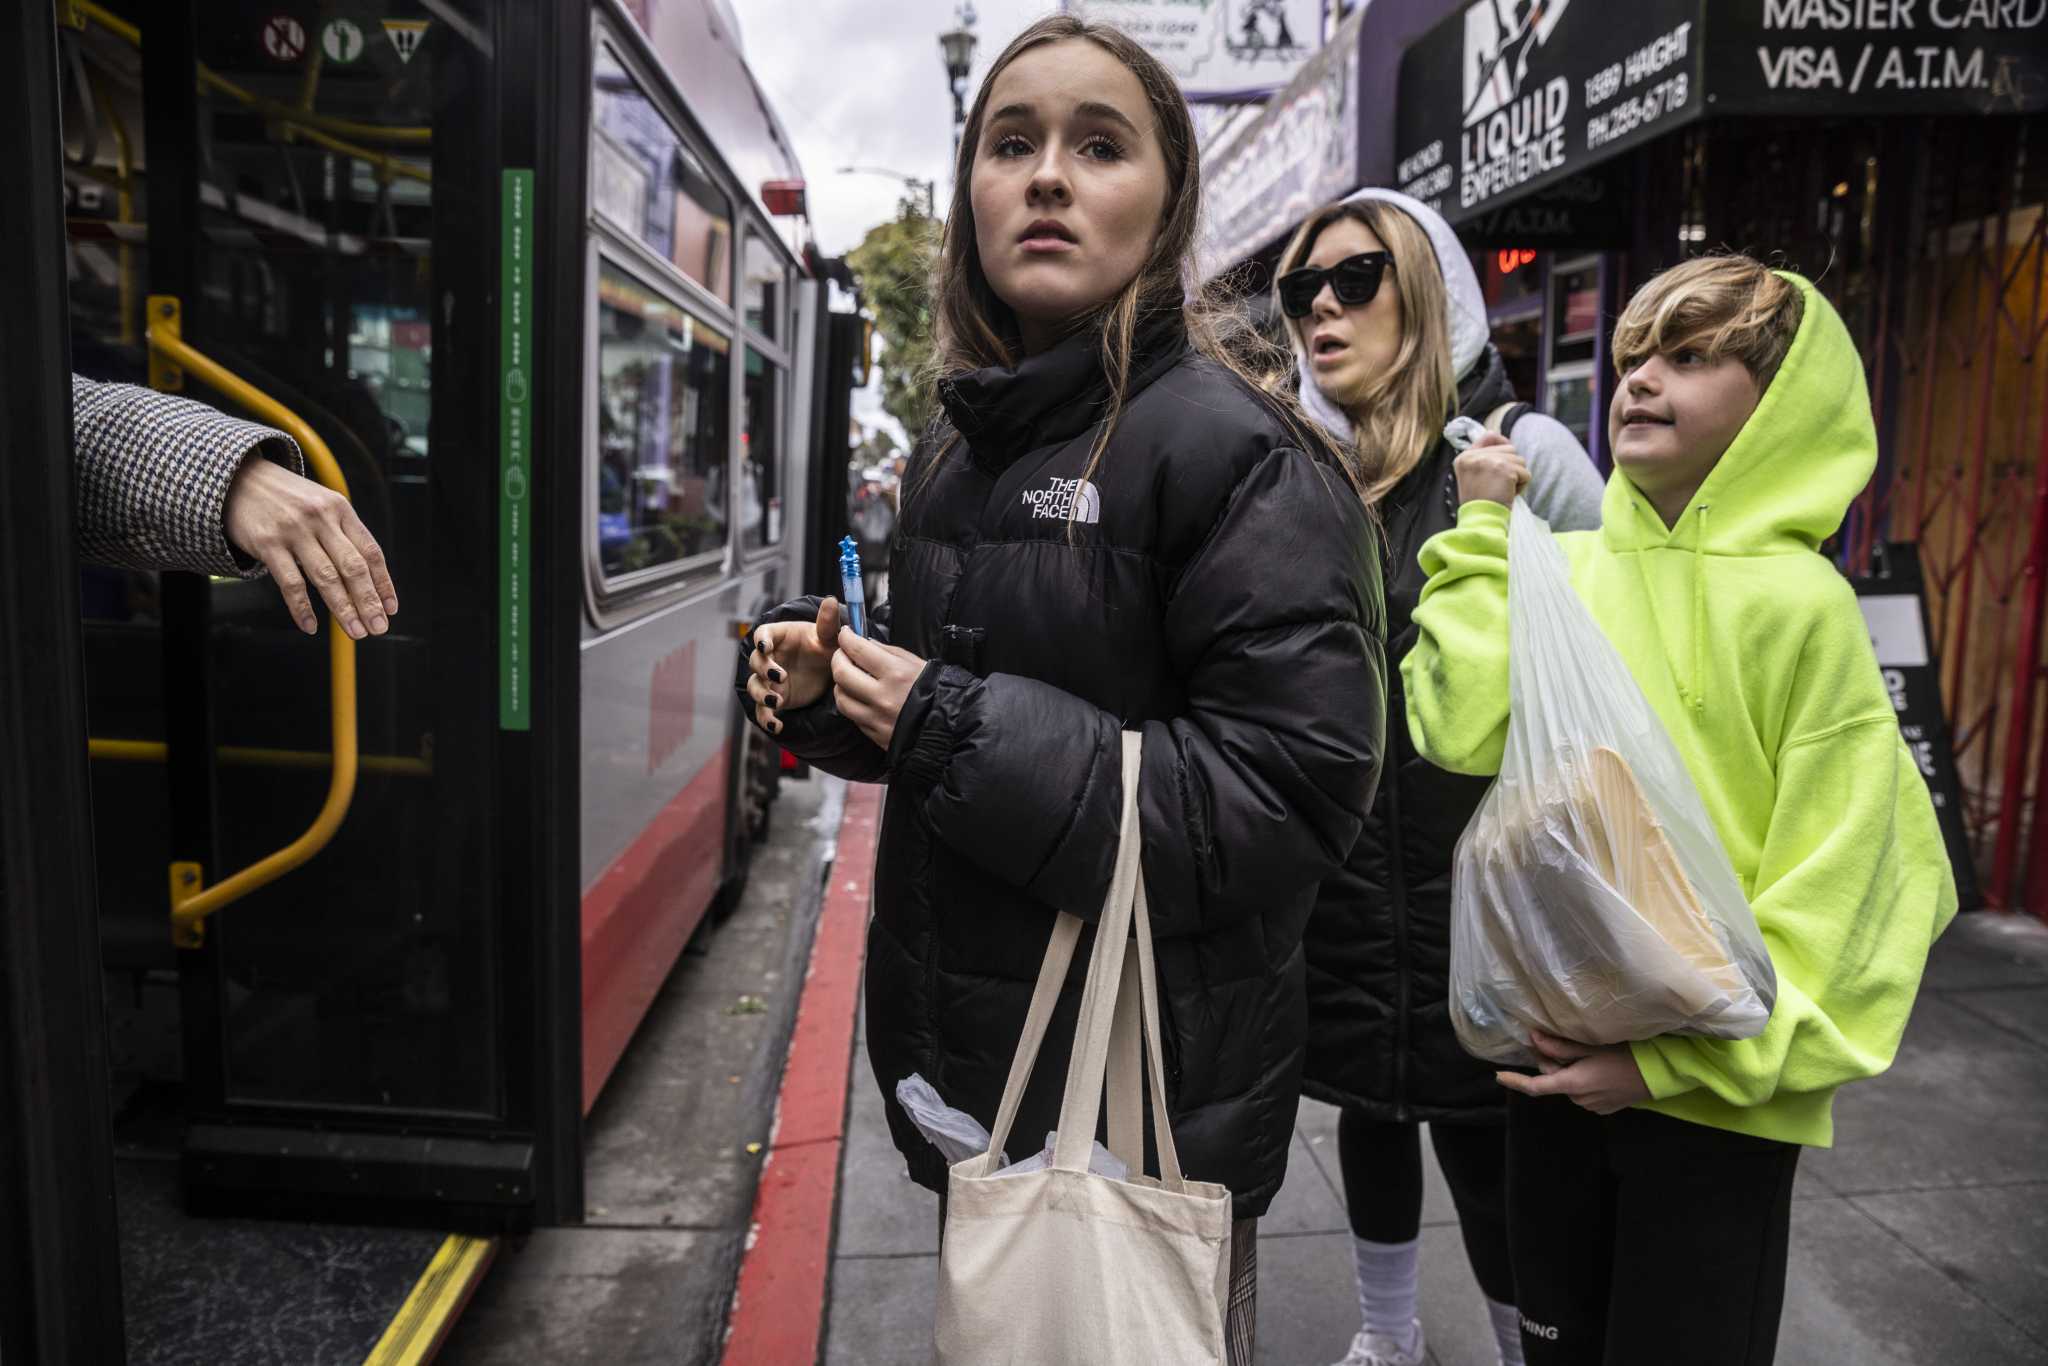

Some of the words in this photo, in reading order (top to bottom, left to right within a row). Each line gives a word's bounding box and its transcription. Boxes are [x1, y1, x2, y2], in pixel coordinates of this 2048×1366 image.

[1762, 0, 1915, 29] MASTER
[1928, 0, 2046, 29] CARD
[1584, 63, 1622, 108] 1589
[1624, 21, 1692, 87] HAIGHT
[1757, 46, 1843, 89] VISA
[1848, 42, 1874, 94] /
[1874, 46, 1989, 89] A.T.M.
[1461, 75, 1569, 172] LIQUID
[1460, 126, 1567, 208] EXPERIENCE
[1021, 489, 1073, 507] NORTH
[1049, 476, 1078, 491] THE
[1032, 504, 1070, 520] FACE
